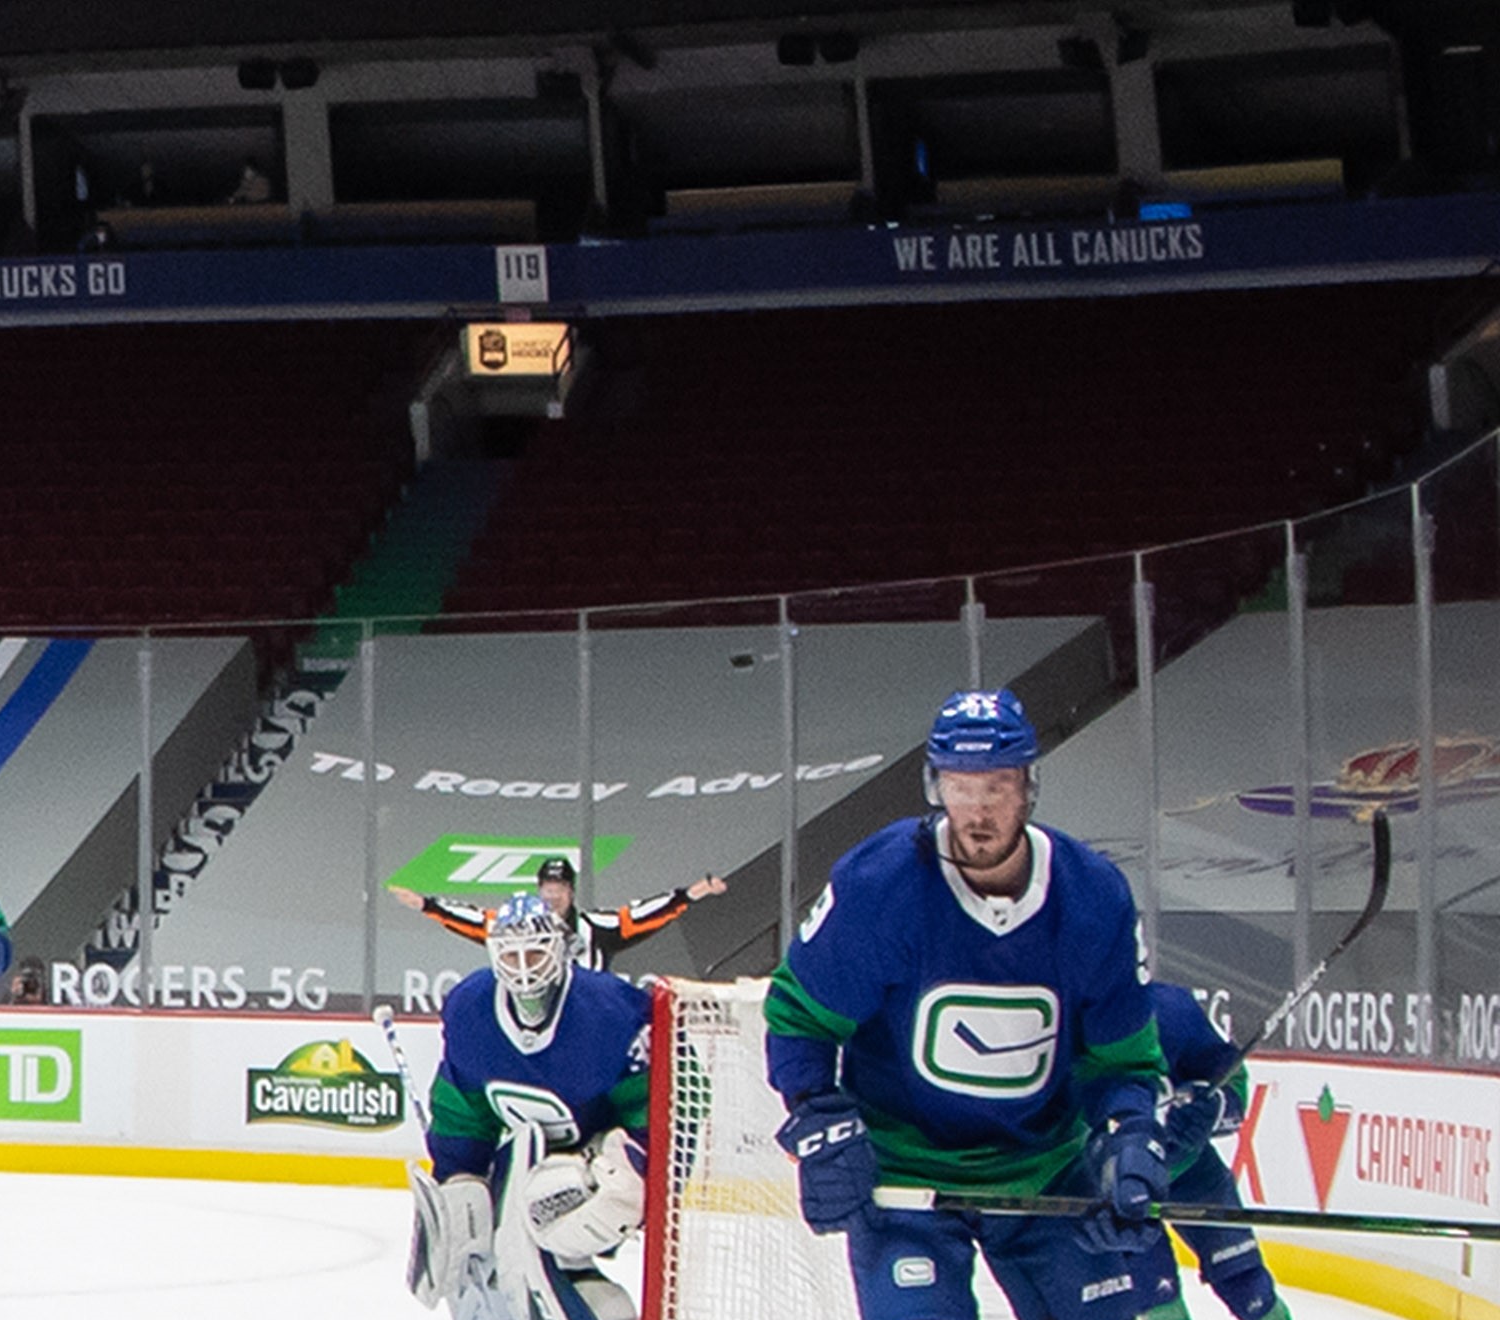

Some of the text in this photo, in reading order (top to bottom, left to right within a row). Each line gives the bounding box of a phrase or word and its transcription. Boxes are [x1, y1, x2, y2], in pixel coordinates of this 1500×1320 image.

[504, 254, 540, 281] 119
[894, 224, 1204, 270] WE ARE ALL CANUCKS
[87, 261, 126, 296] GO
[52, 962, 328, 1011] ROGERS 5G
[1404, 995, 1434, 1054] 5G
[255, 1078, 398, 1118] Cavendish
[1356, 1112, 1456, 1197] CANADIAN
